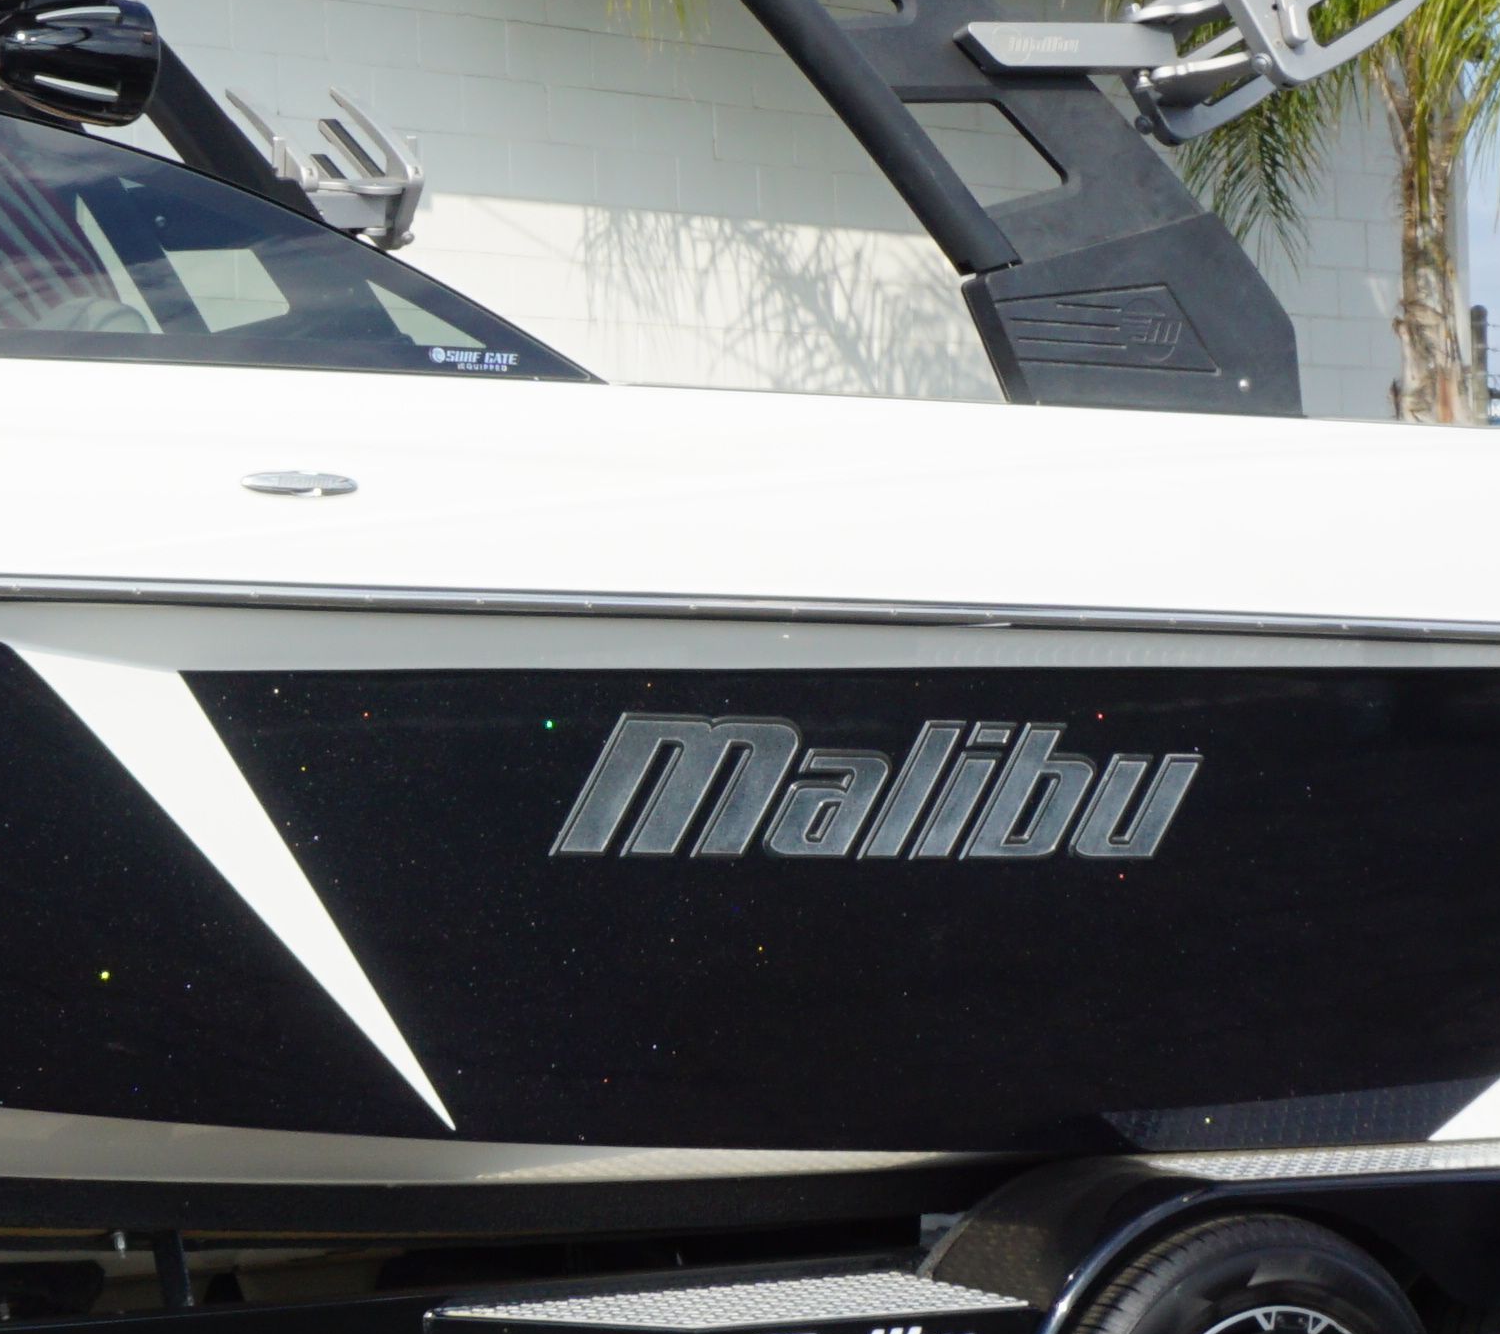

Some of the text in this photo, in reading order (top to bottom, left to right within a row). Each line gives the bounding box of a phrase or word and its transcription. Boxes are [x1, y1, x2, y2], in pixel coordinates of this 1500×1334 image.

[446, 350, 519, 365] SURF GATE
[457, 362, 508, 372] EQUIPPED
[548, 711, 1203, 861] Malibu
